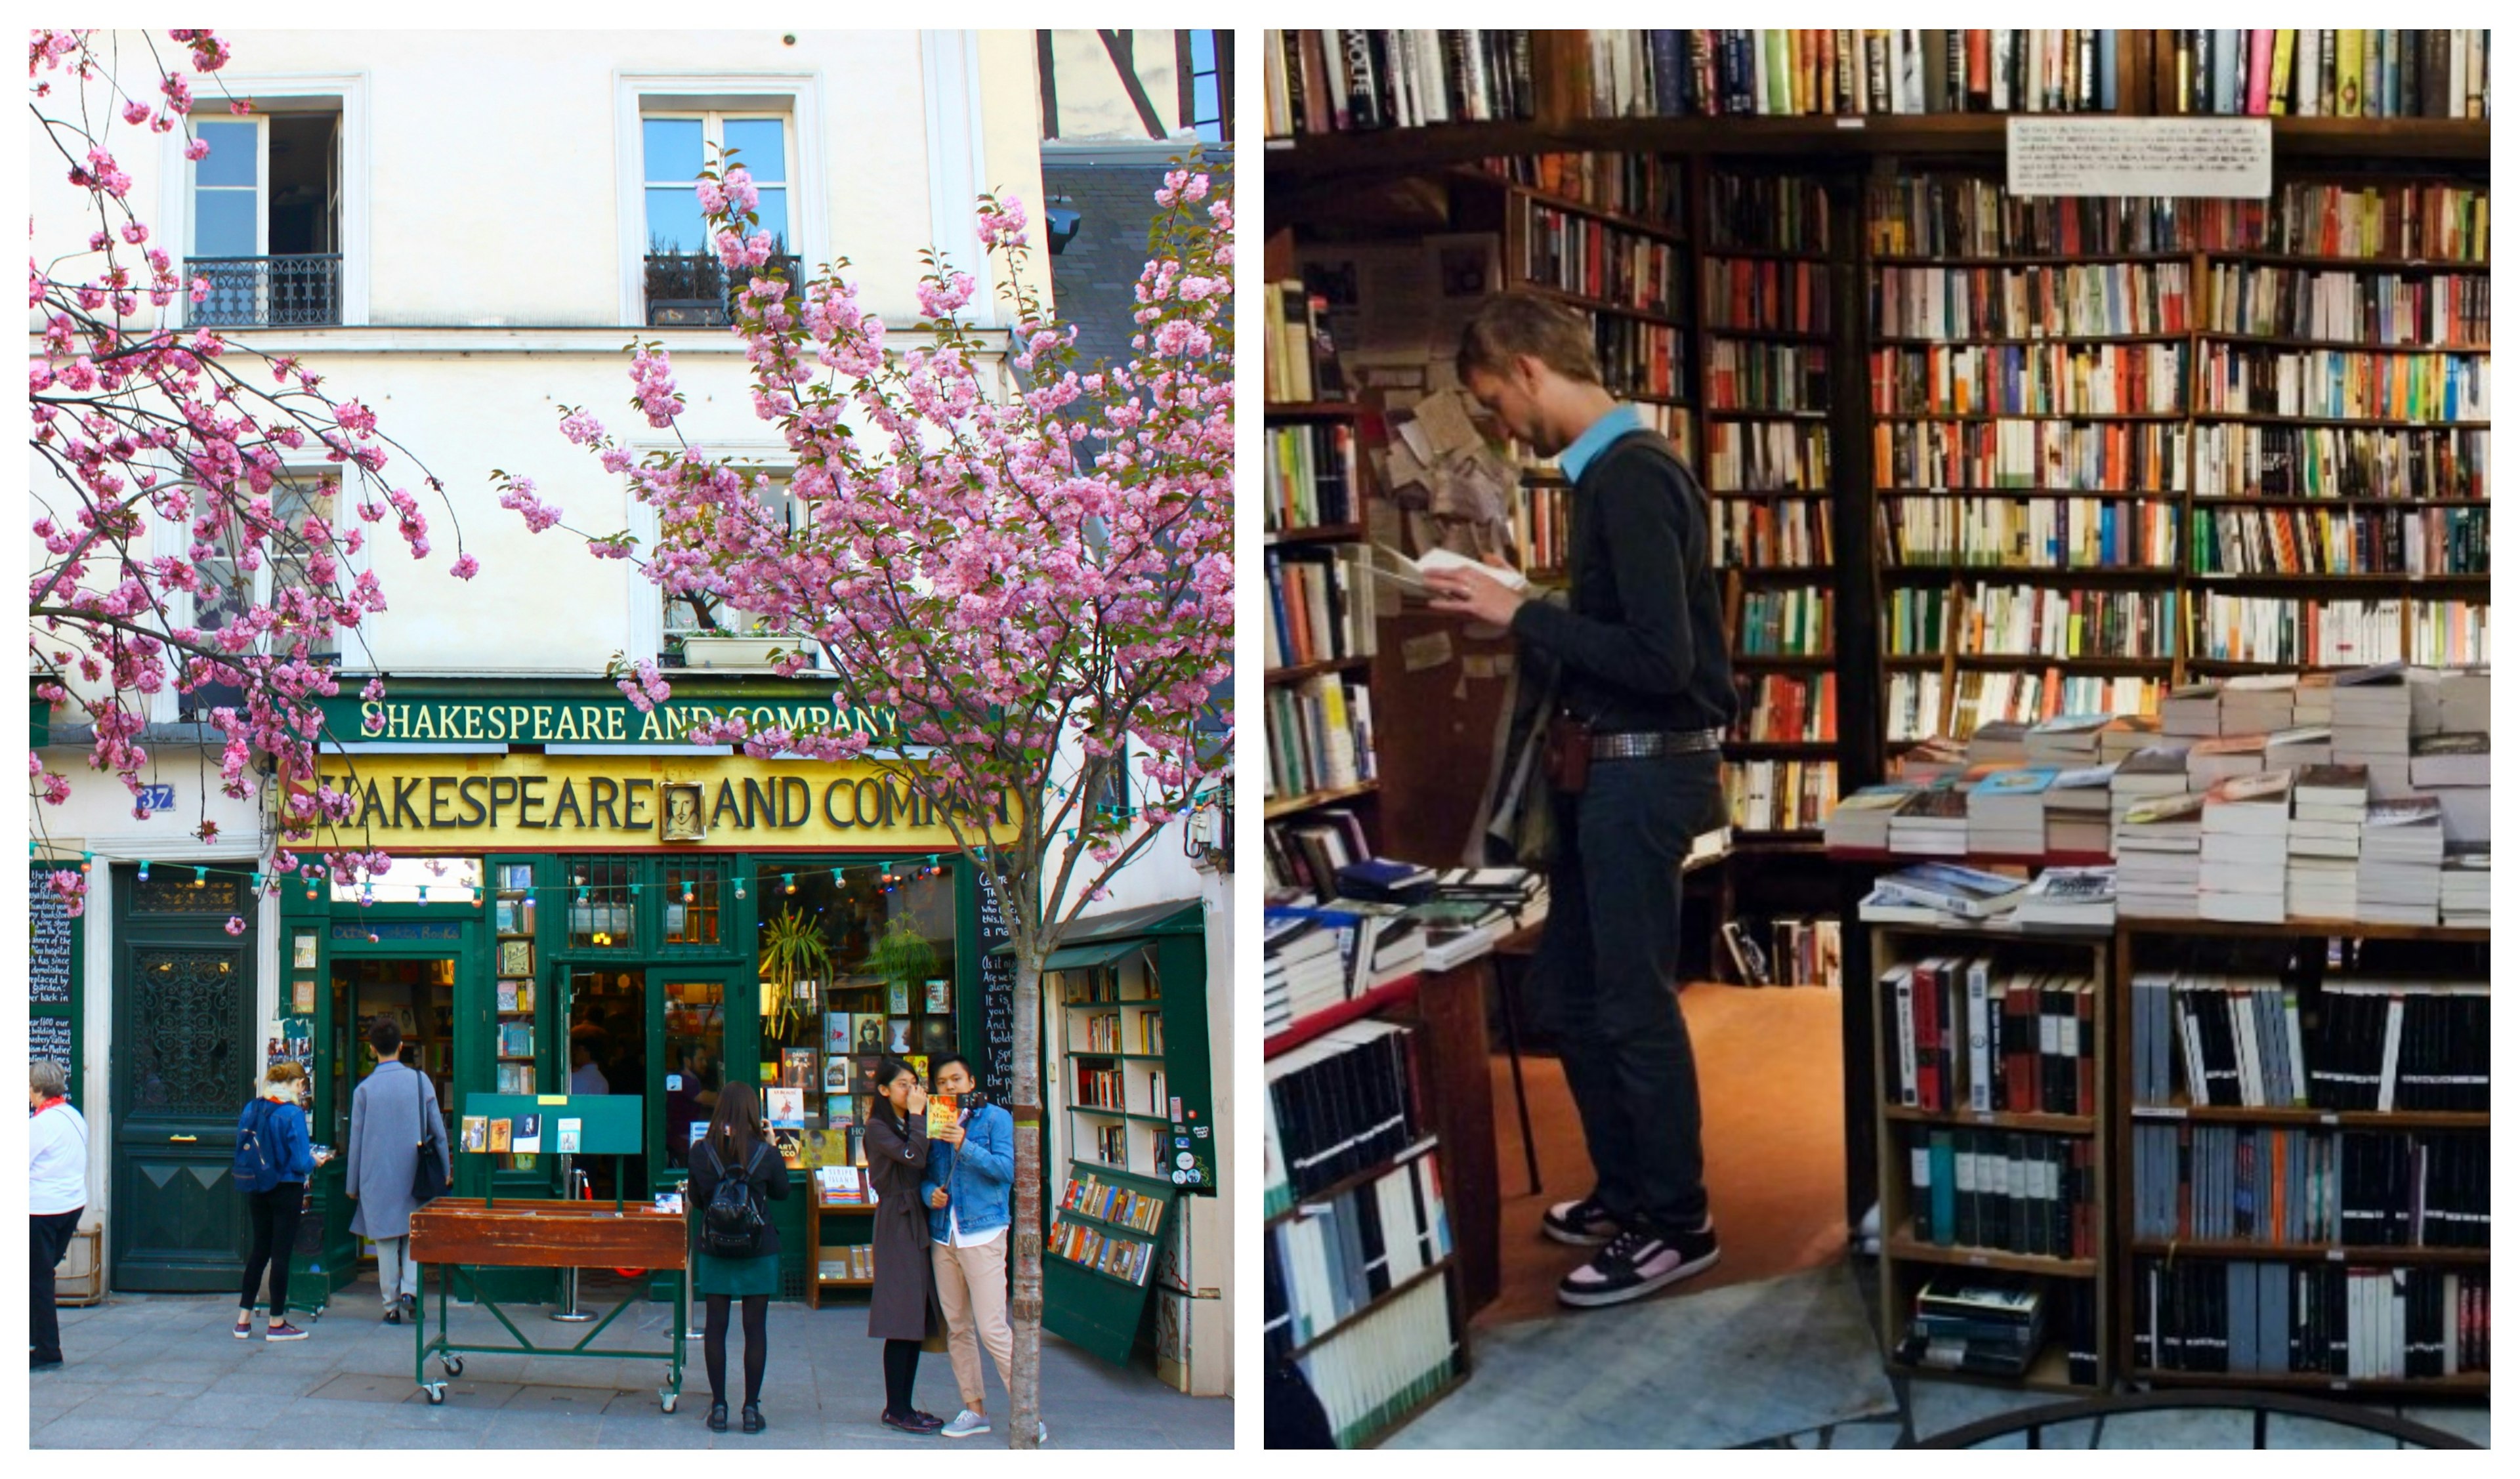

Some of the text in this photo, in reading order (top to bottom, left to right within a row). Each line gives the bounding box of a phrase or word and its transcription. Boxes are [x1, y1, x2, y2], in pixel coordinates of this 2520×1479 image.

[360, 700, 627, 740] SHAKESPEARE
[639, 707, 713, 740] AND
[142, 788, 169, 808] 37
[713, 776, 811, 828] AND
[824, 774, 1011, 829] COMPAN
[984, 927, 1009, 937] a ma
[60, 936, 71, 946] the
[45, 944, 70, 957] hospital
[32, 965, 70, 975] demolished
[60, 976, 69, 986] by
[983, 971, 997, 982] Are
[40, 993, 58, 1002] back
[60, 993, 68, 1002] in
[985, 995, 1009, 1006] It is
[988, 1008, 1005, 1019] you
[986, 1018, 1006, 1030] And
[30, 1035, 50, 1046] astery
[995, 1061, 1013, 1075] fro
[987, 1074, 1002, 1087] the
[996, 1093, 1013, 1106] int
